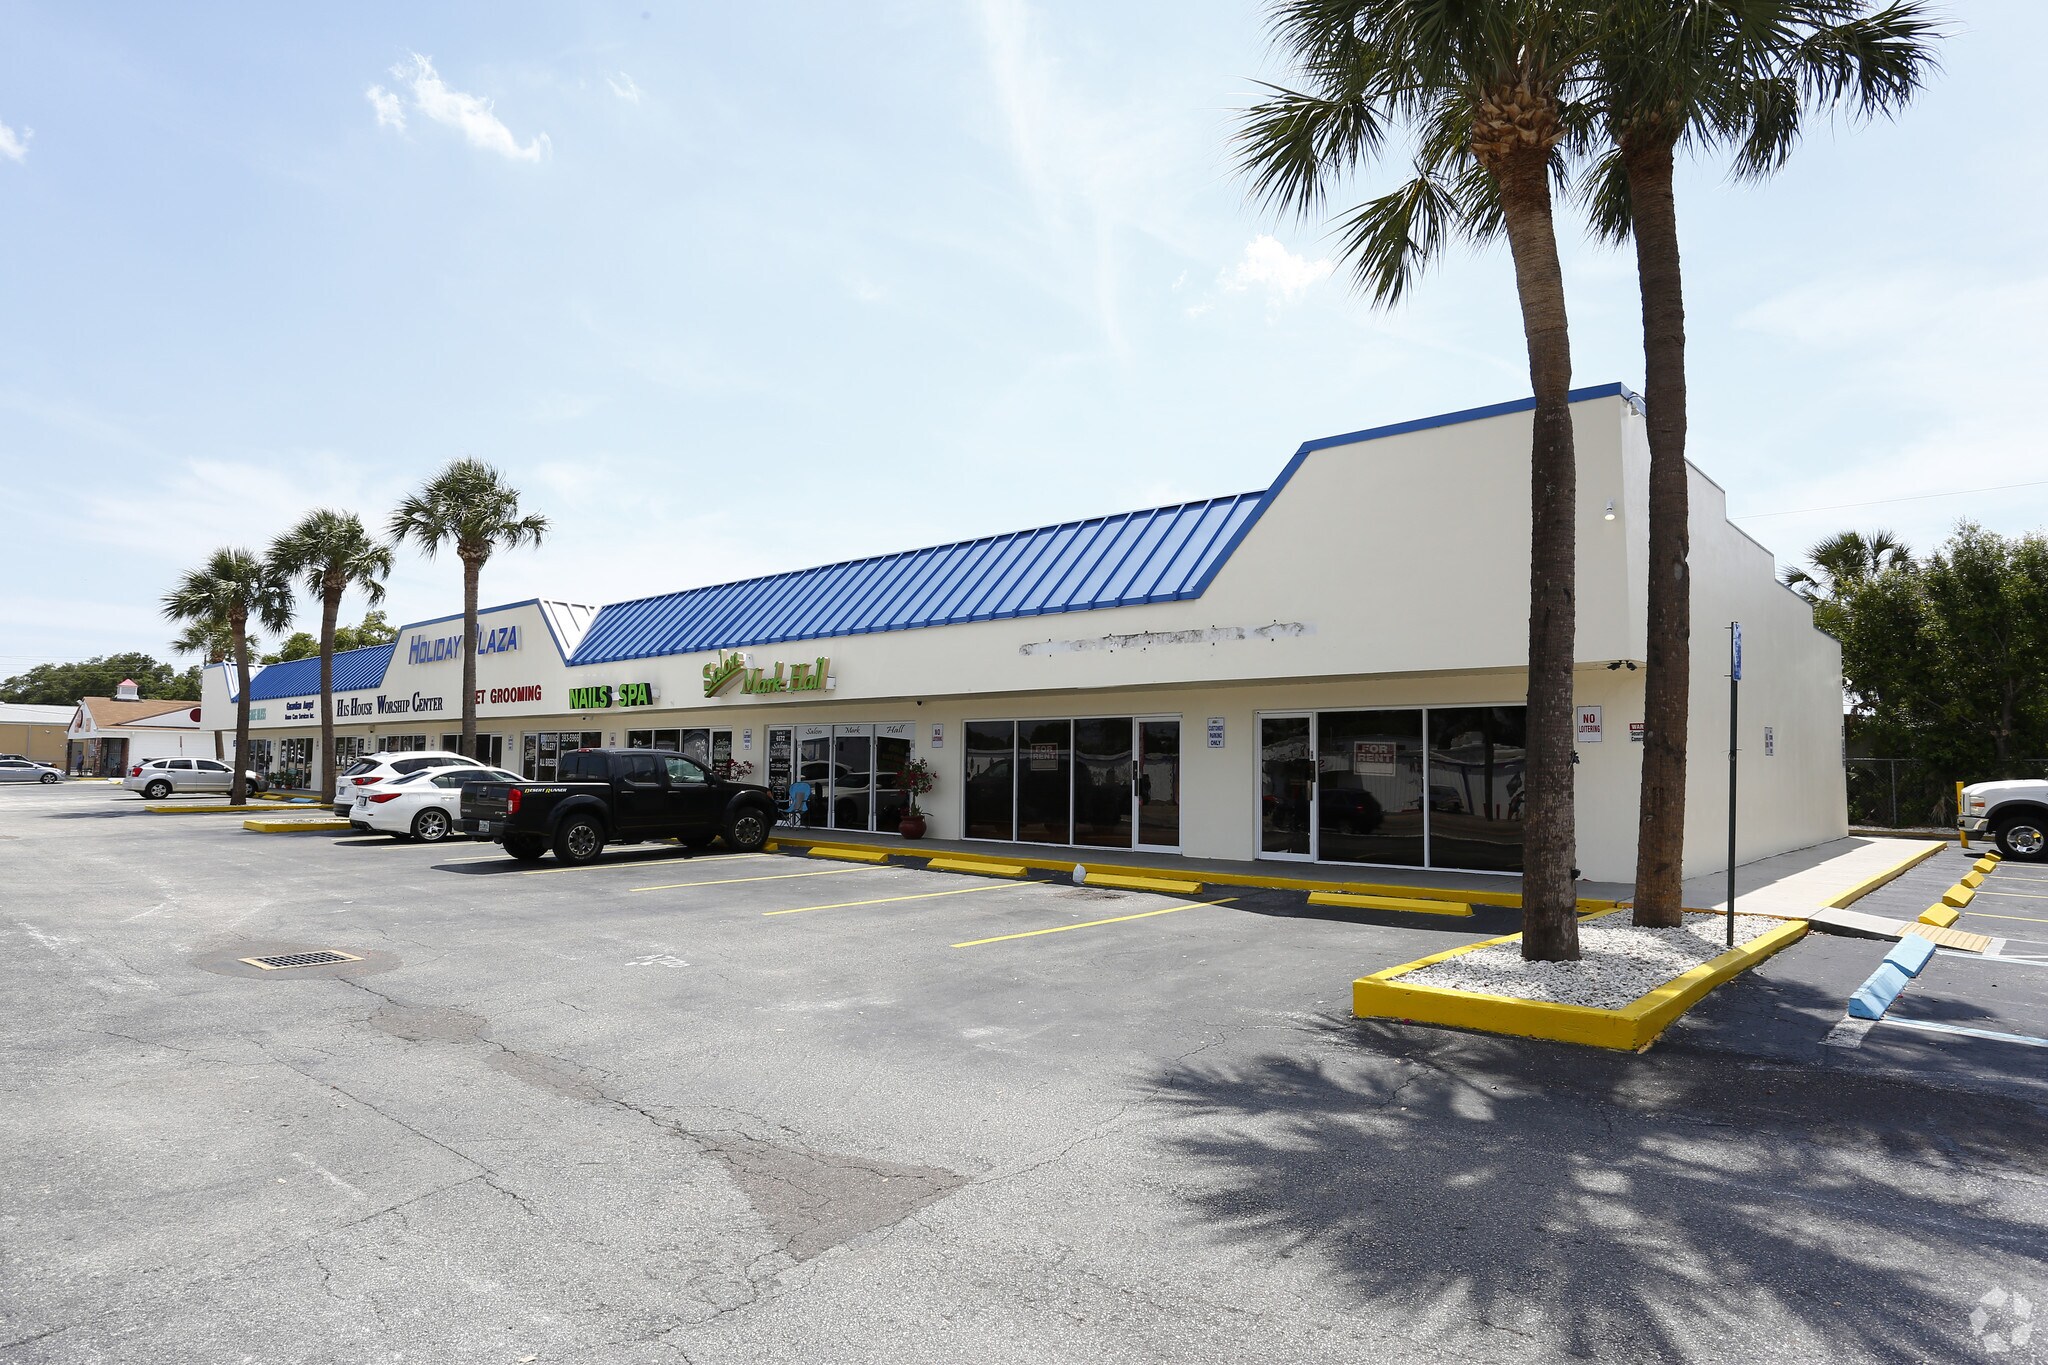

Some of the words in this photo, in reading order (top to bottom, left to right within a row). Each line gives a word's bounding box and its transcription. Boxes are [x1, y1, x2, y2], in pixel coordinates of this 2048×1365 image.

[408, 634, 462, 665] HOLIDAY
[477, 624, 519, 655] LAZA
[703, 649, 744, 691] Salon
[740, 661, 785, 694] Mark
[787, 657, 830, 691] Hall
[336, 699, 350, 717] HIS
[350, 698, 373, 716] HOUSE
[377, 695, 410, 714] WORSHIP
[412, 692, 443, 712] CENTER
[475, 689, 486, 705] ET
[490, 685, 542, 704] GROOMING
[569, 686, 611, 709] NAILS
[618, 683, 653, 707] SPA
[1583, 713, 1596, 724] NO
[805, 727, 823, 735] Salon
[845, 726, 861, 734] Mark
[886, 724, 905, 734] Hall
[1578, 724, 1601, 734] LOITERING
[1357, 754, 1393, 763] RENT
[1361, 744, 1388, 754] FOR
